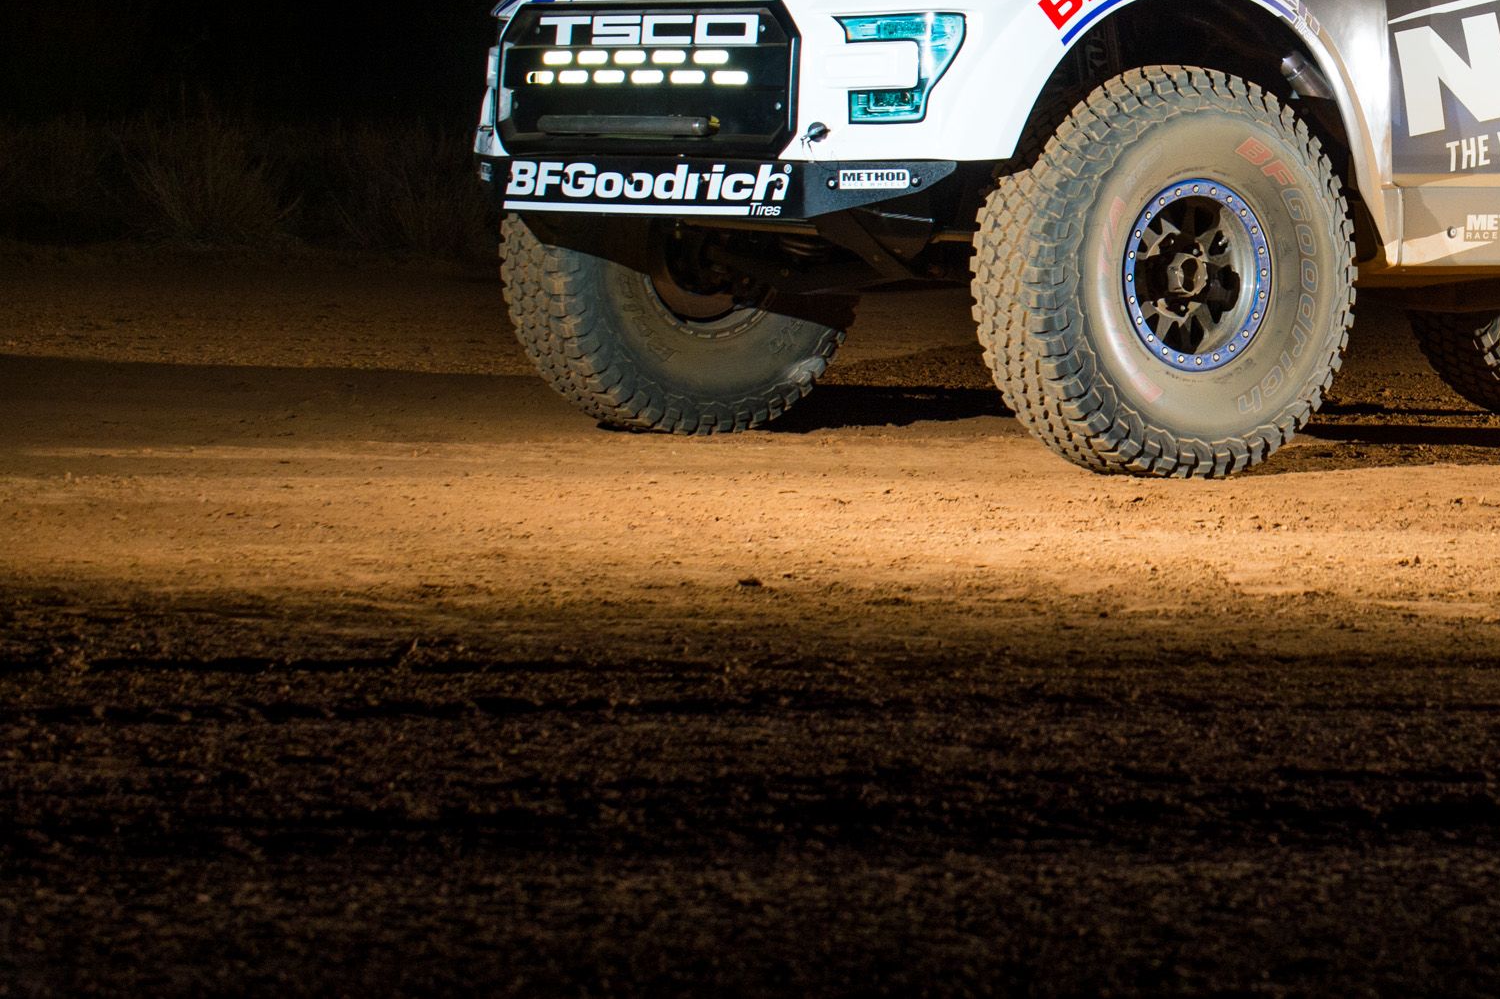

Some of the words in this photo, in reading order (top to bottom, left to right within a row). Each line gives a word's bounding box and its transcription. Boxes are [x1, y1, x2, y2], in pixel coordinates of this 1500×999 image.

[539, 14, 759, 46] TSCO
[1446, 134, 1491, 172] THE
[842, 172, 907, 182] METHOD
[748, 201, 782, 217] Tires
[1466, 231, 1498, 240] RACE
